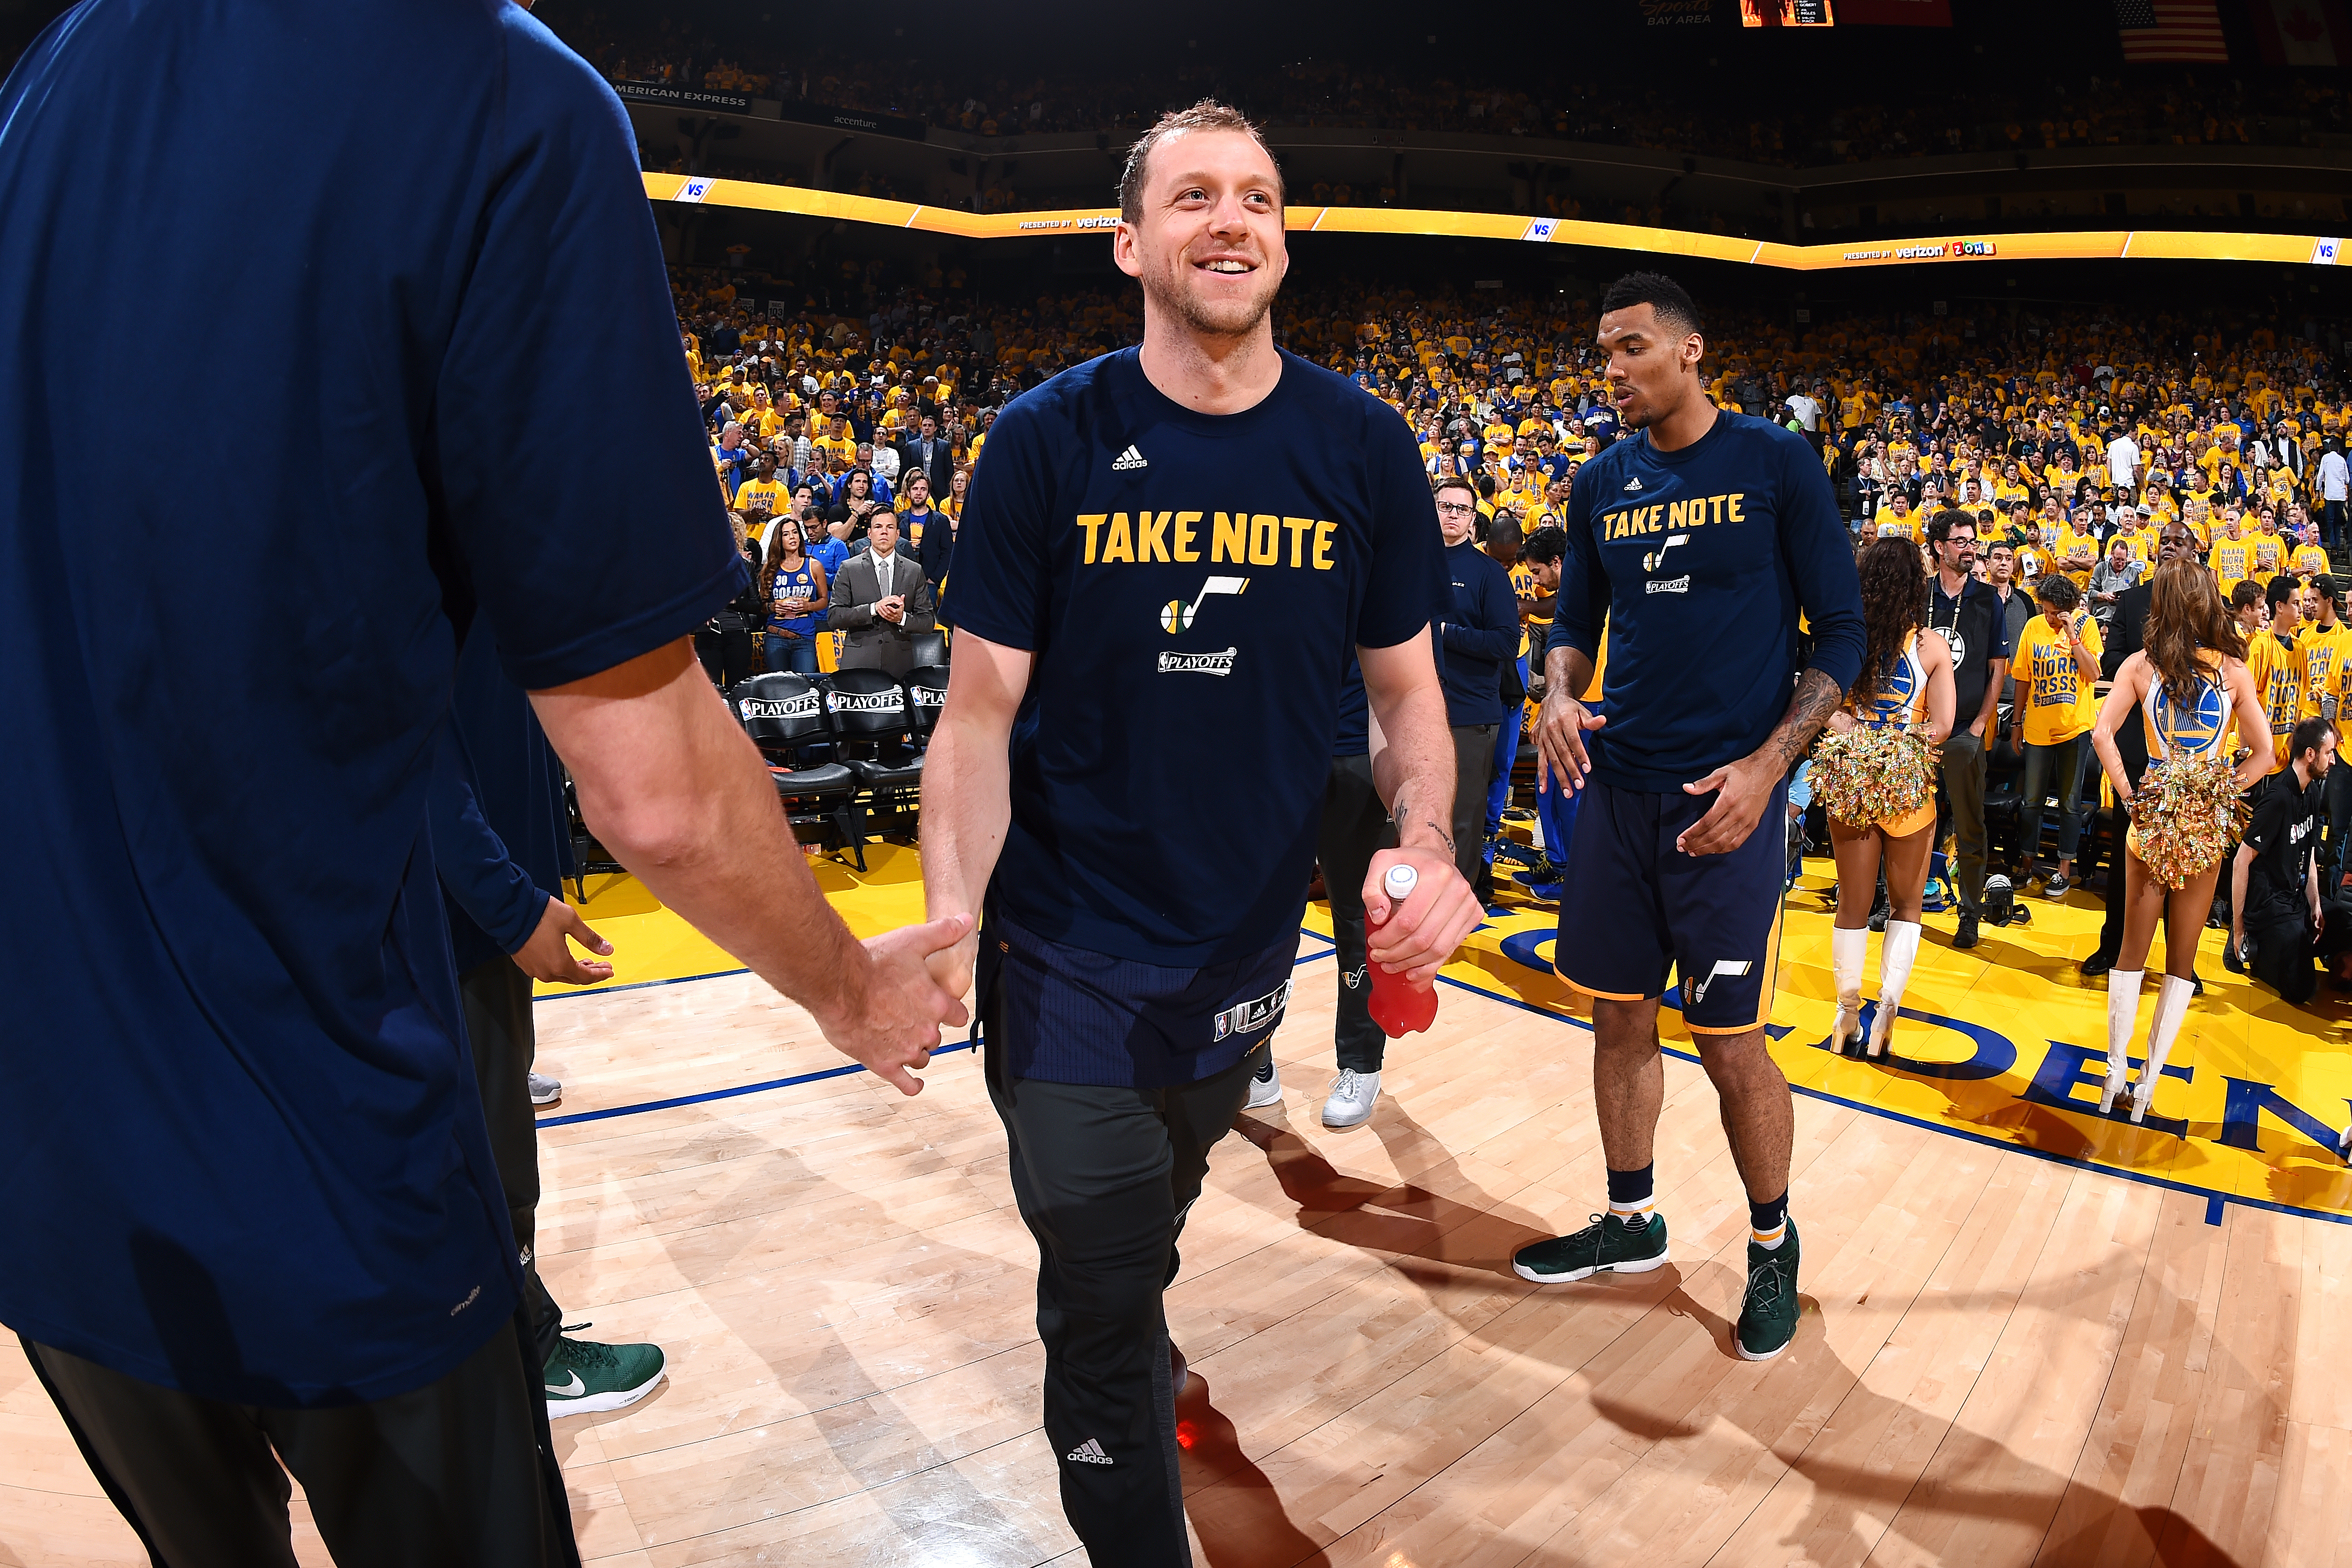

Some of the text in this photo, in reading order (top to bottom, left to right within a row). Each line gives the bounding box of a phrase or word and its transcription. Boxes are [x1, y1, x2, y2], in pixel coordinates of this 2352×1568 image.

[1647, 15, 1711, 25] BAY AREA
[614, 85, 746, 106] MERICAN EXPRESS
[834, 115, 877, 129] accenture
[688, 184, 703, 197] VS
[1019, 220, 1060, 229] PRESENTED
[1534, 224, 1549, 236] VS
[1843, 242, 1995, 260] PRESENTED BY verizon ZOHO
[2319, 244, 2333, 257] VS
[769, 307, 783, 316] 103
[1112, 459, 1148, 470] adidas
[1603, 493, 1745, 541] TAKE NOTE
[1077, 511, 1338, 570] TAKE NOTE
[2221, 547, 2244, 557] WAAAR
[2221, 555, 2244, 565] RIORR
[775, 575, 788, 586] 30
[1650, 580, 1688, 591] PLAYOFFS
[773, 585, 814, 600] GOLDEN
[1166, 655, 1234, 669] PLAYOFFS
[2033, 656, 2079, 678] RIORR
[751, 696, 820, 716] PLAYOFFS
[837, 692, 904, 709] PLAYOFFS
[2042, 695, 2057, 705] 2017
[1067, 1452, 1114, 1465] adidas
